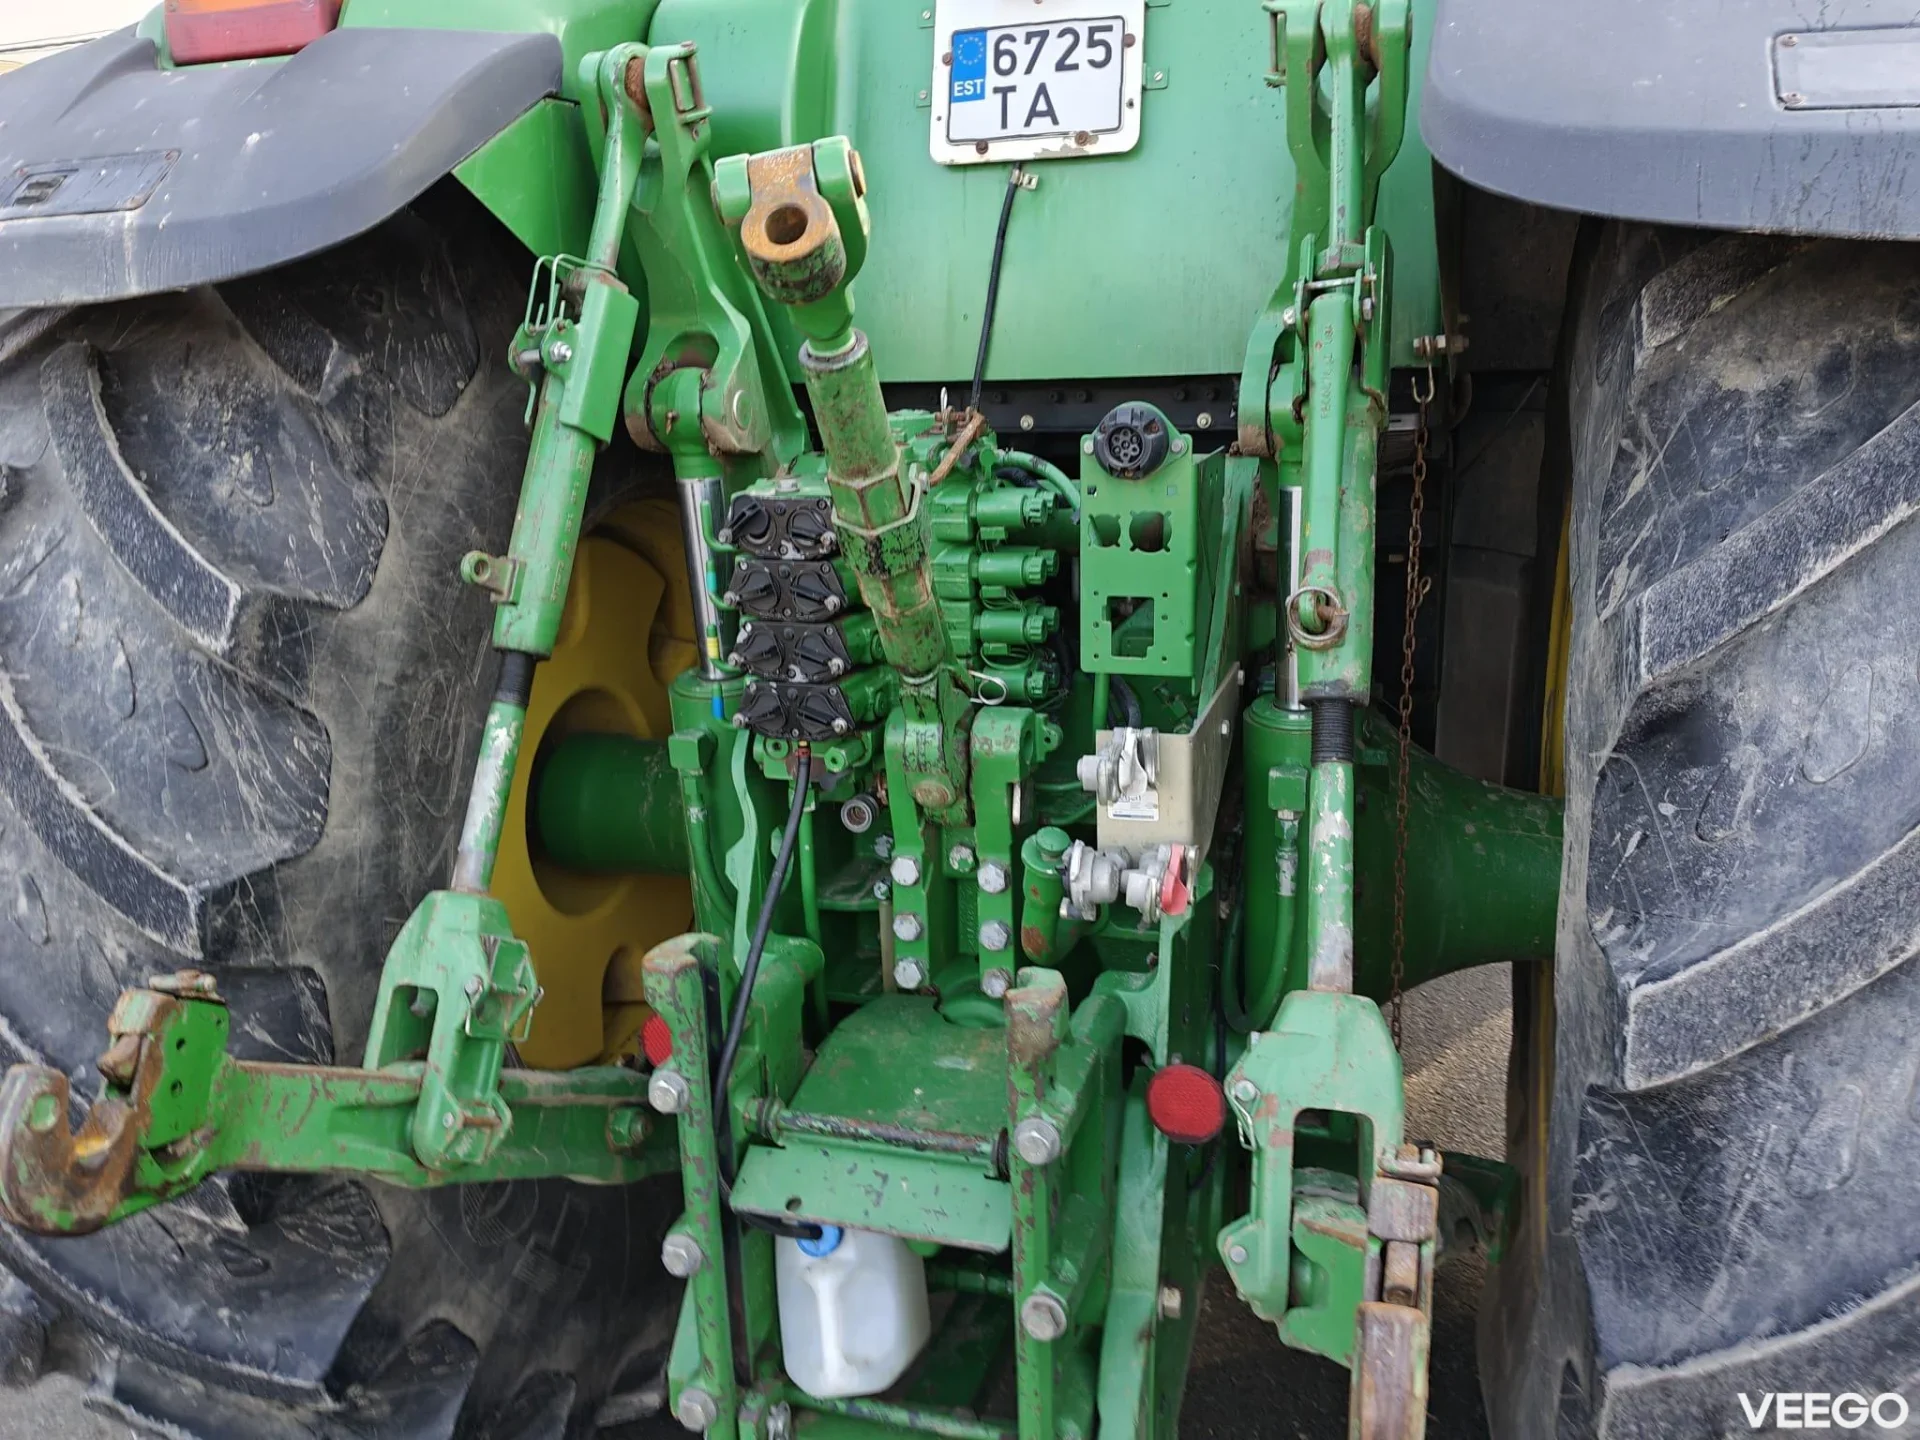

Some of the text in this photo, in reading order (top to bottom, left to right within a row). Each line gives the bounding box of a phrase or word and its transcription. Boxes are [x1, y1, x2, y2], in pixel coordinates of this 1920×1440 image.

[993, 24, 1114, 76] 6725
[953, 79, 984, 97] EST
[992, 82, 1059, 130] TA
